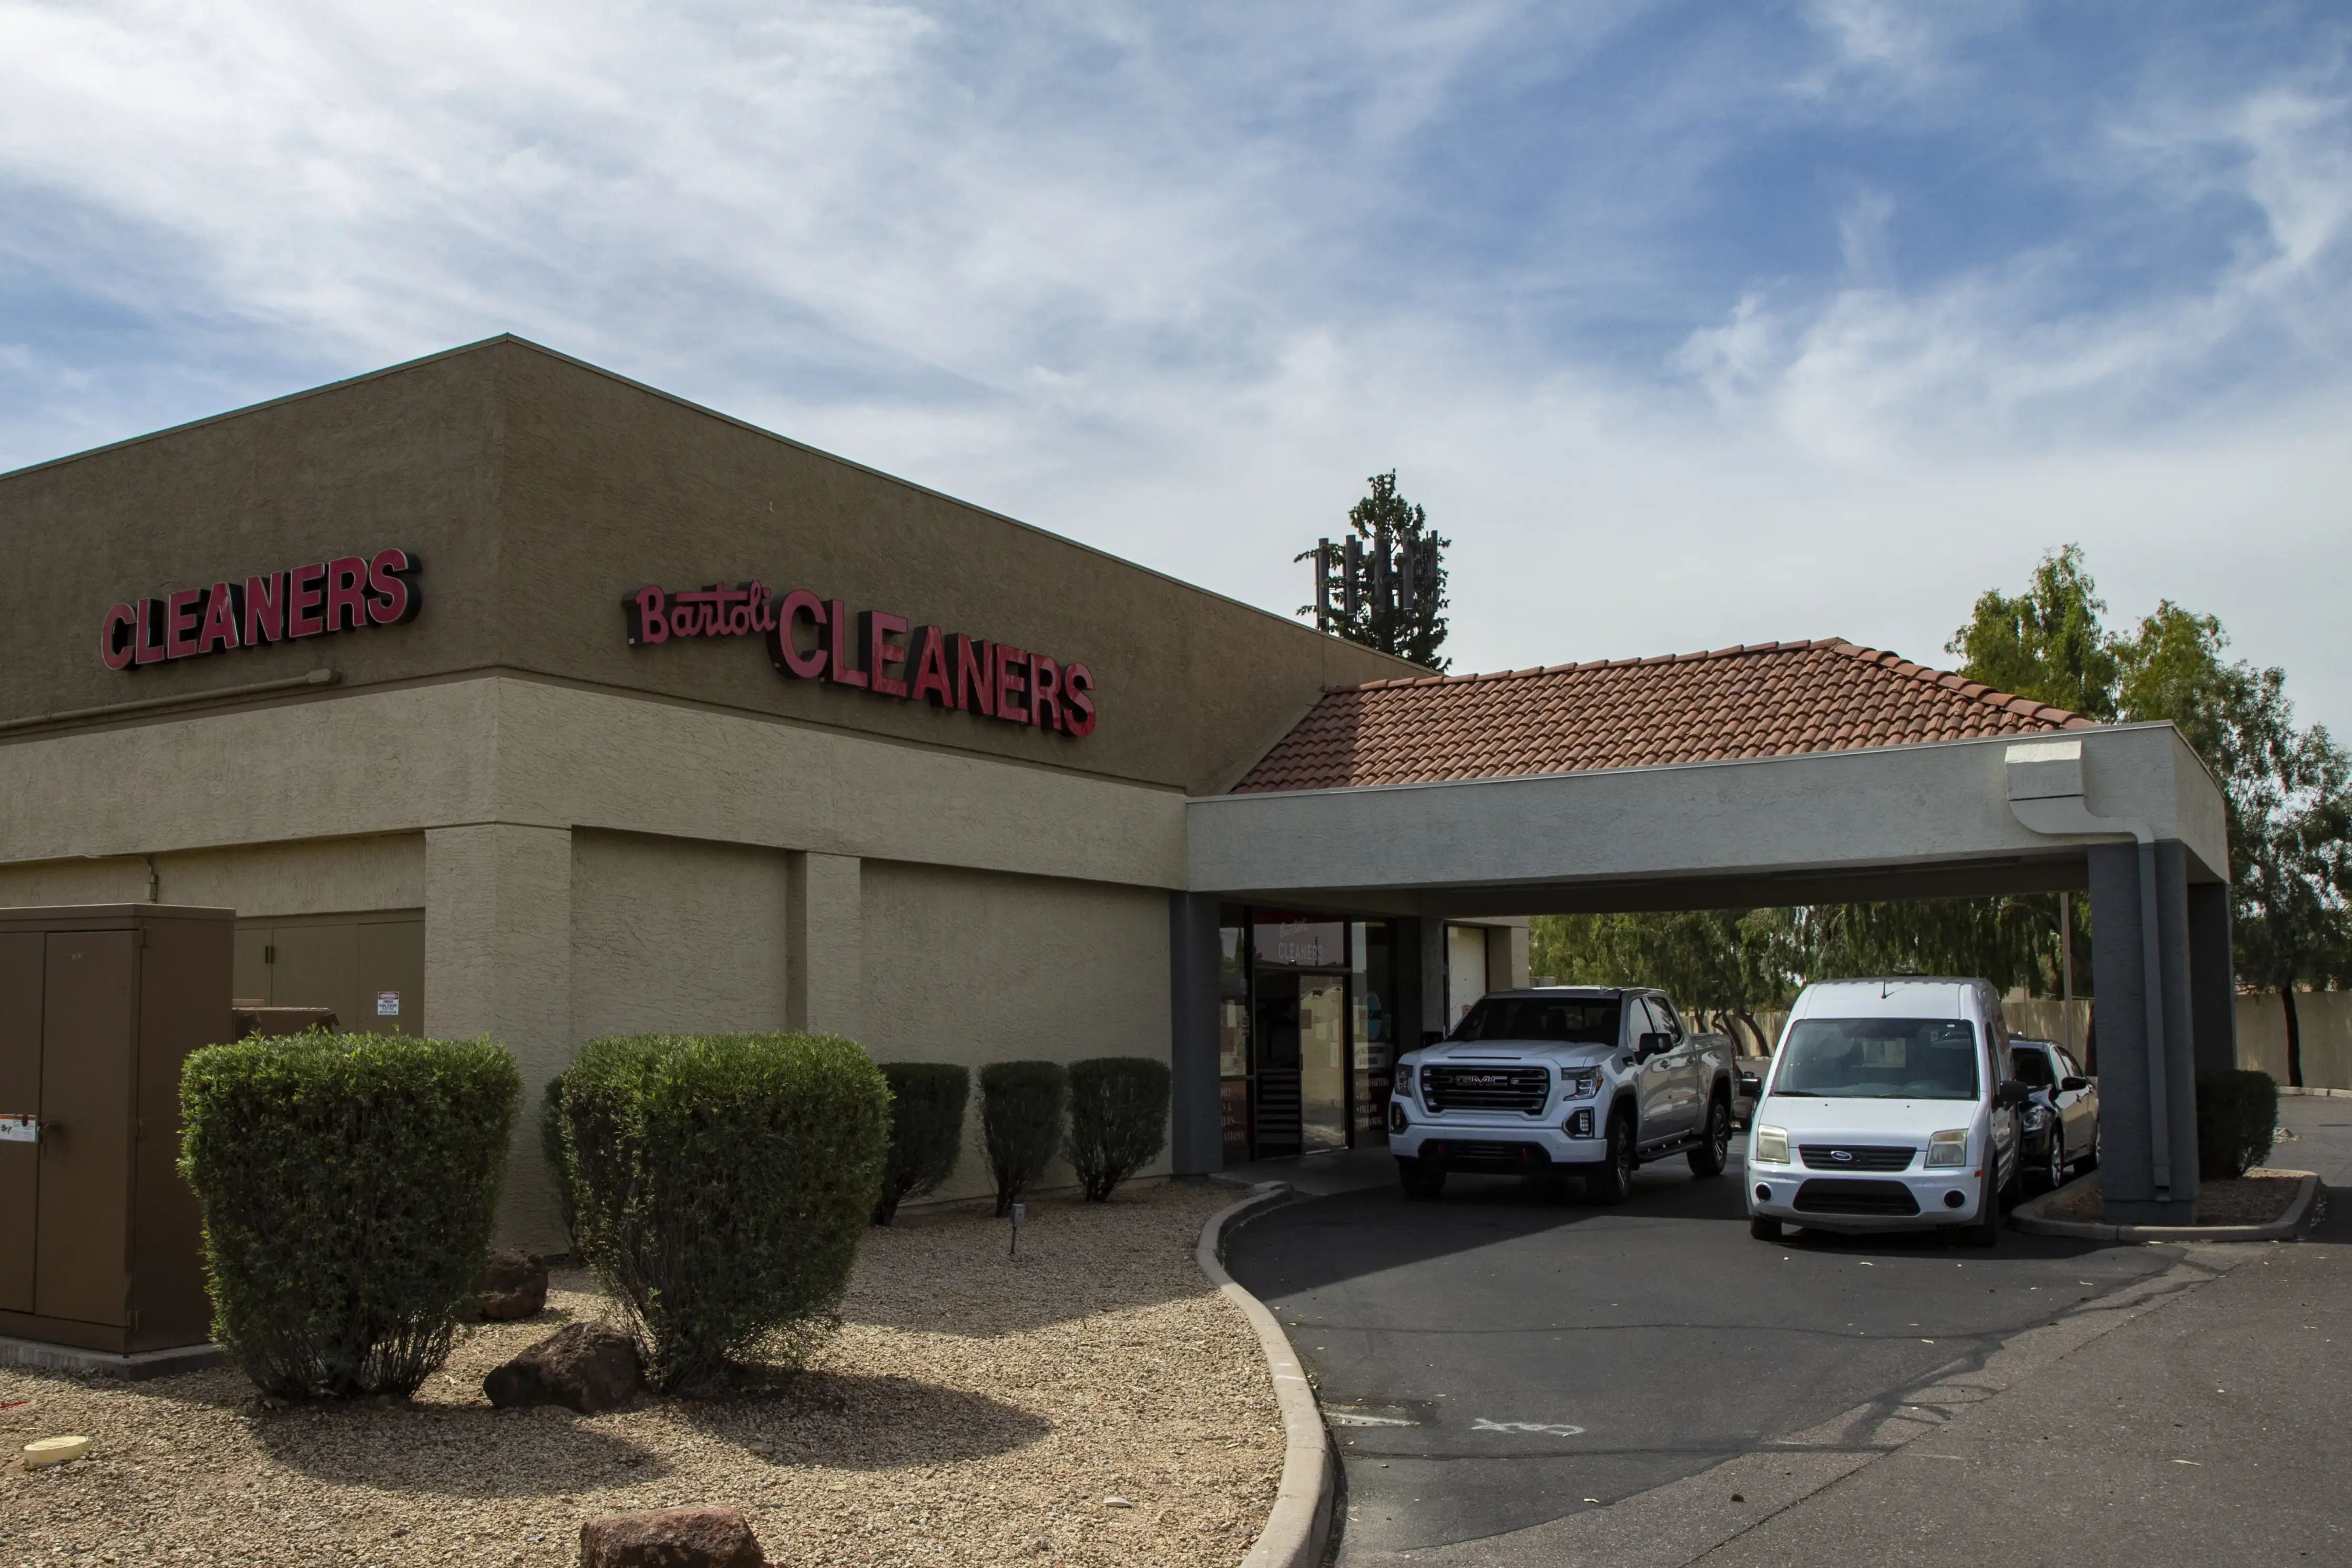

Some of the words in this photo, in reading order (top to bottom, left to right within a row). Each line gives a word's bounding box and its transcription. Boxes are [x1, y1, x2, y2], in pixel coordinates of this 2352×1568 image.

[101, 548, 408, 670] CLEANERS
[636, 579, 776, 643] Bartoli
[780, 589, 1096, 736] CLEANERS
[1279, 942, 1323, 962] CLEANERS
[1455, 1075, 1508, 1088] GMC
[1359, 1104, 1377, 1113] PILLOW
